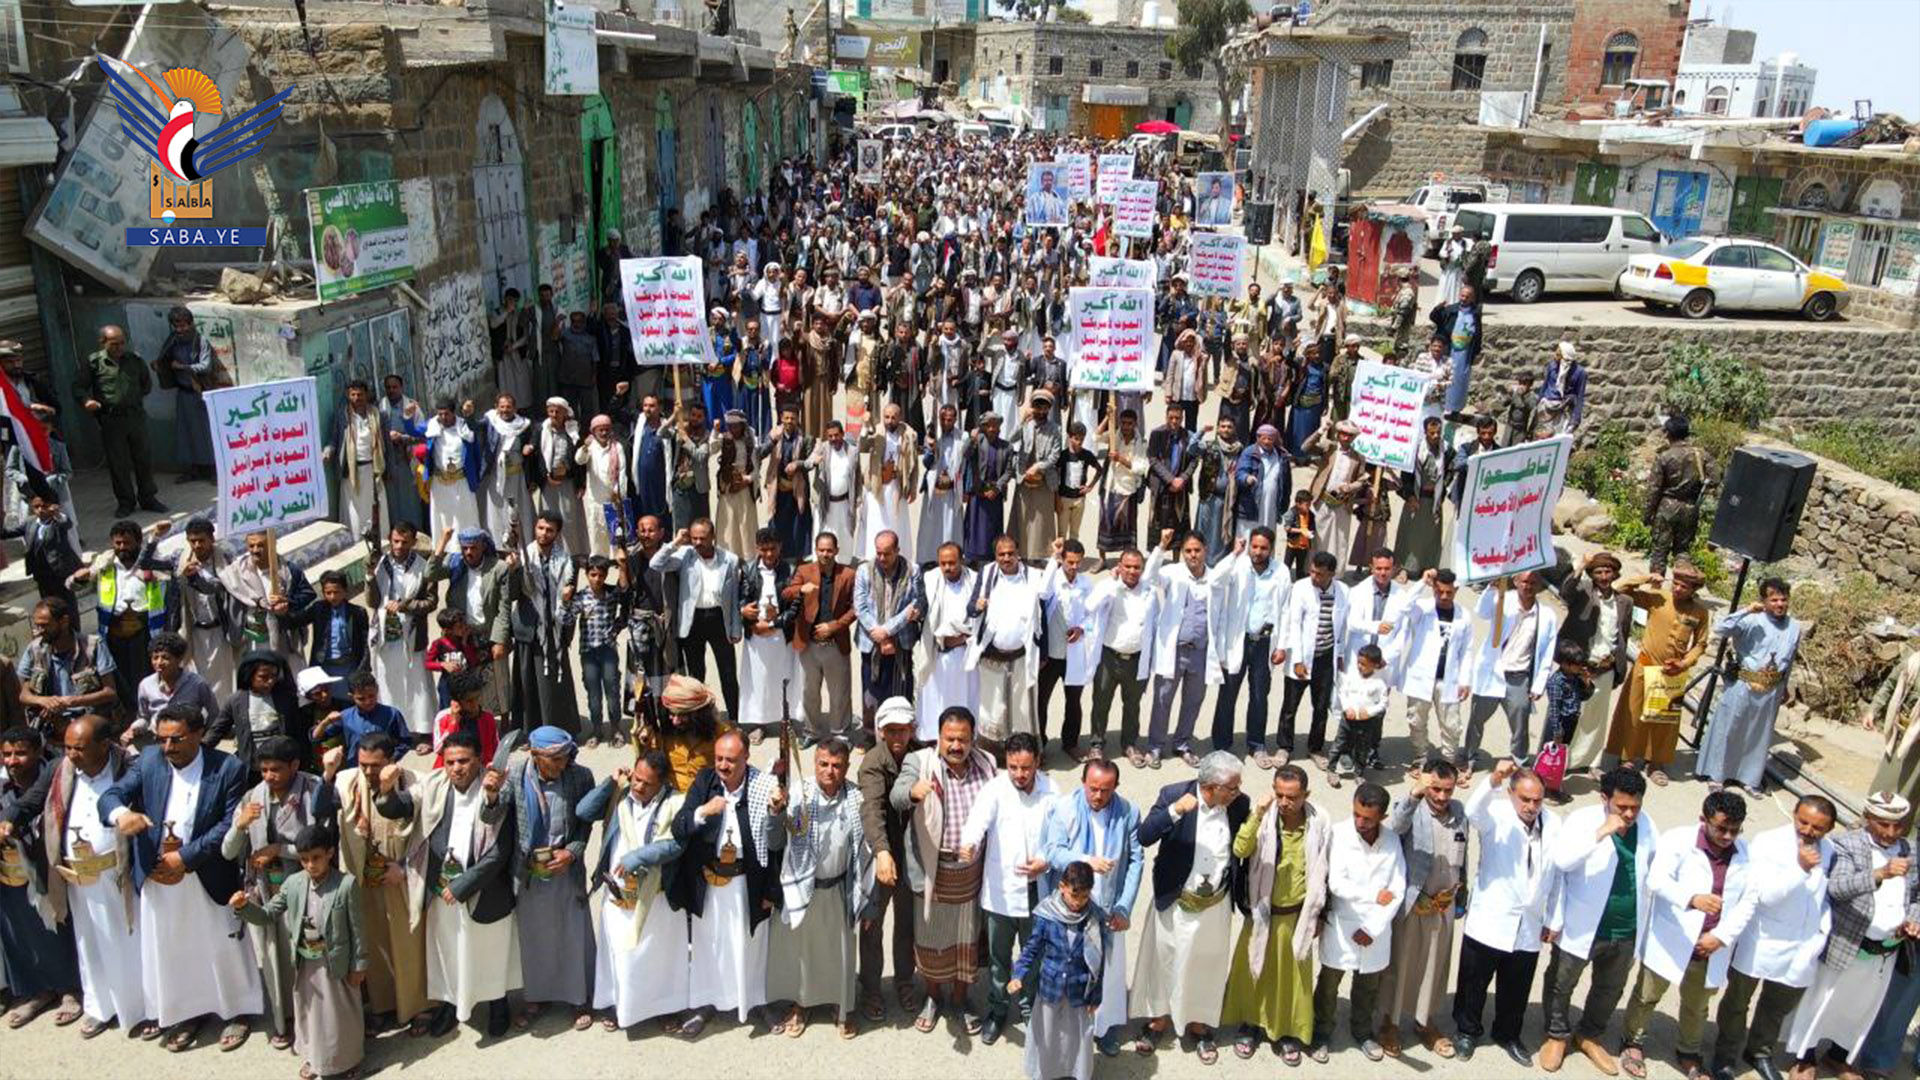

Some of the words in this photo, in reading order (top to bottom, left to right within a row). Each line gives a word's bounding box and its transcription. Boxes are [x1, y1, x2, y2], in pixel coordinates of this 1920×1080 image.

[634, 260, 668, 287] أكبر
[671, 263, 692, 281] الله
[670, 290, 694, 301] الموت
[1081, 293, 1118, 315] أكبر
[1119, 294, 1143, 312] الله
[1114, 319, 1142, 331] الموت
[644, 341, 676, 360] للإسلام
[681, 340, 705, 357] النصر
[1115, 335, 1142, 347] الموت
[1362, 370, 1400, 389] أكبر
[1400, 376, 1424, 393] الله
[224, 390, 271, 428] أكبر
[275, 390, 306, 413] الله
[226, 424, 269, 450] لأمريكا
[272, 421, 308, 442] الموت
[231, 450, 271, 477] لإسرائيل
[274, 445, 310, 466] الموت
[285, 468, 312, 486] اللعنة
[1480, 453, 1552, 491] قاطعوا
[231, 477, 260, 500] اليهود
[264, 473, 280, 493] على
[231, 499, 273, 530] للإسلام
[279, 490, 315, 521] النصر
[1472, 533, 1538, 569] الإسرائيلية
